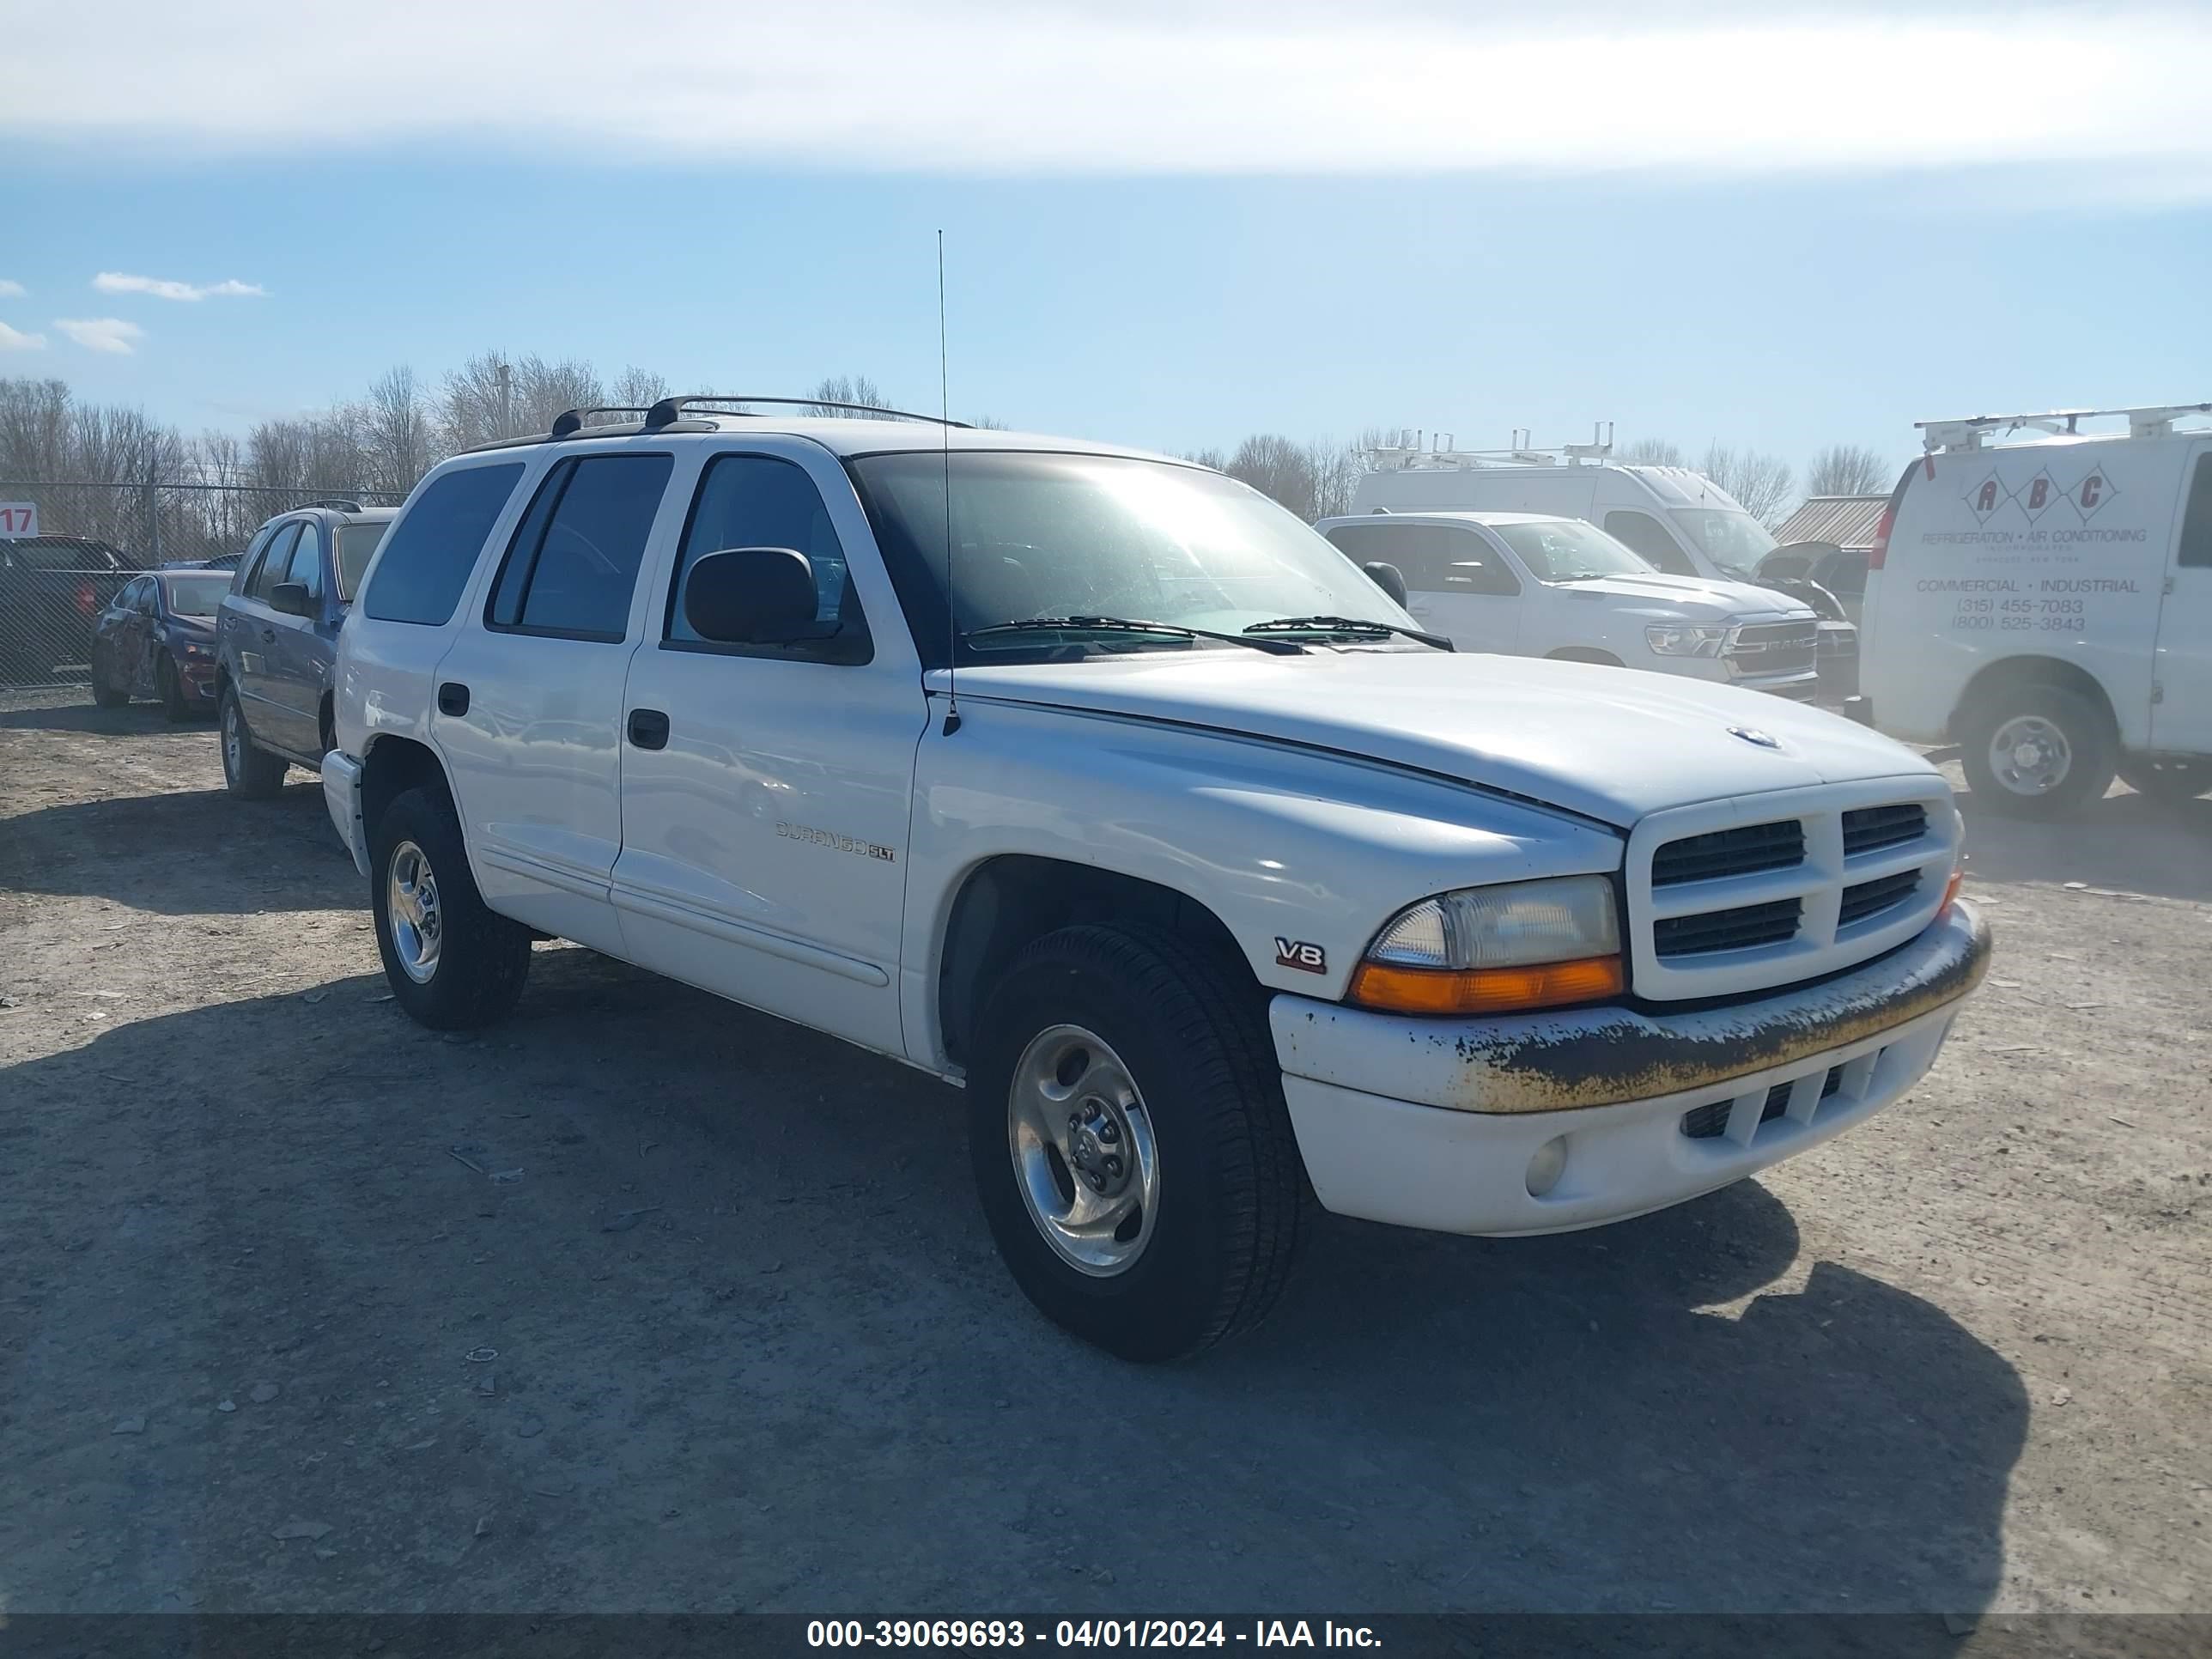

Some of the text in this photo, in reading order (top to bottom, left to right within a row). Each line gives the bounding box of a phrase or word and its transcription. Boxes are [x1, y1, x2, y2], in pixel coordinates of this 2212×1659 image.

[1922, 529, 2147, 544] REFRIGERATION AIR CONDITIONING
[1916, 579, 2141, 592] COMMERCIAL INDUSTRIAL
[1957, 599, 2084, 614] (315) 455-7083
[1951, 616, 2086, 632] (800) 525-3843
[775, 820, 896, 862] DURANGO SLT
[1274, 936, 1325, 967] V8
